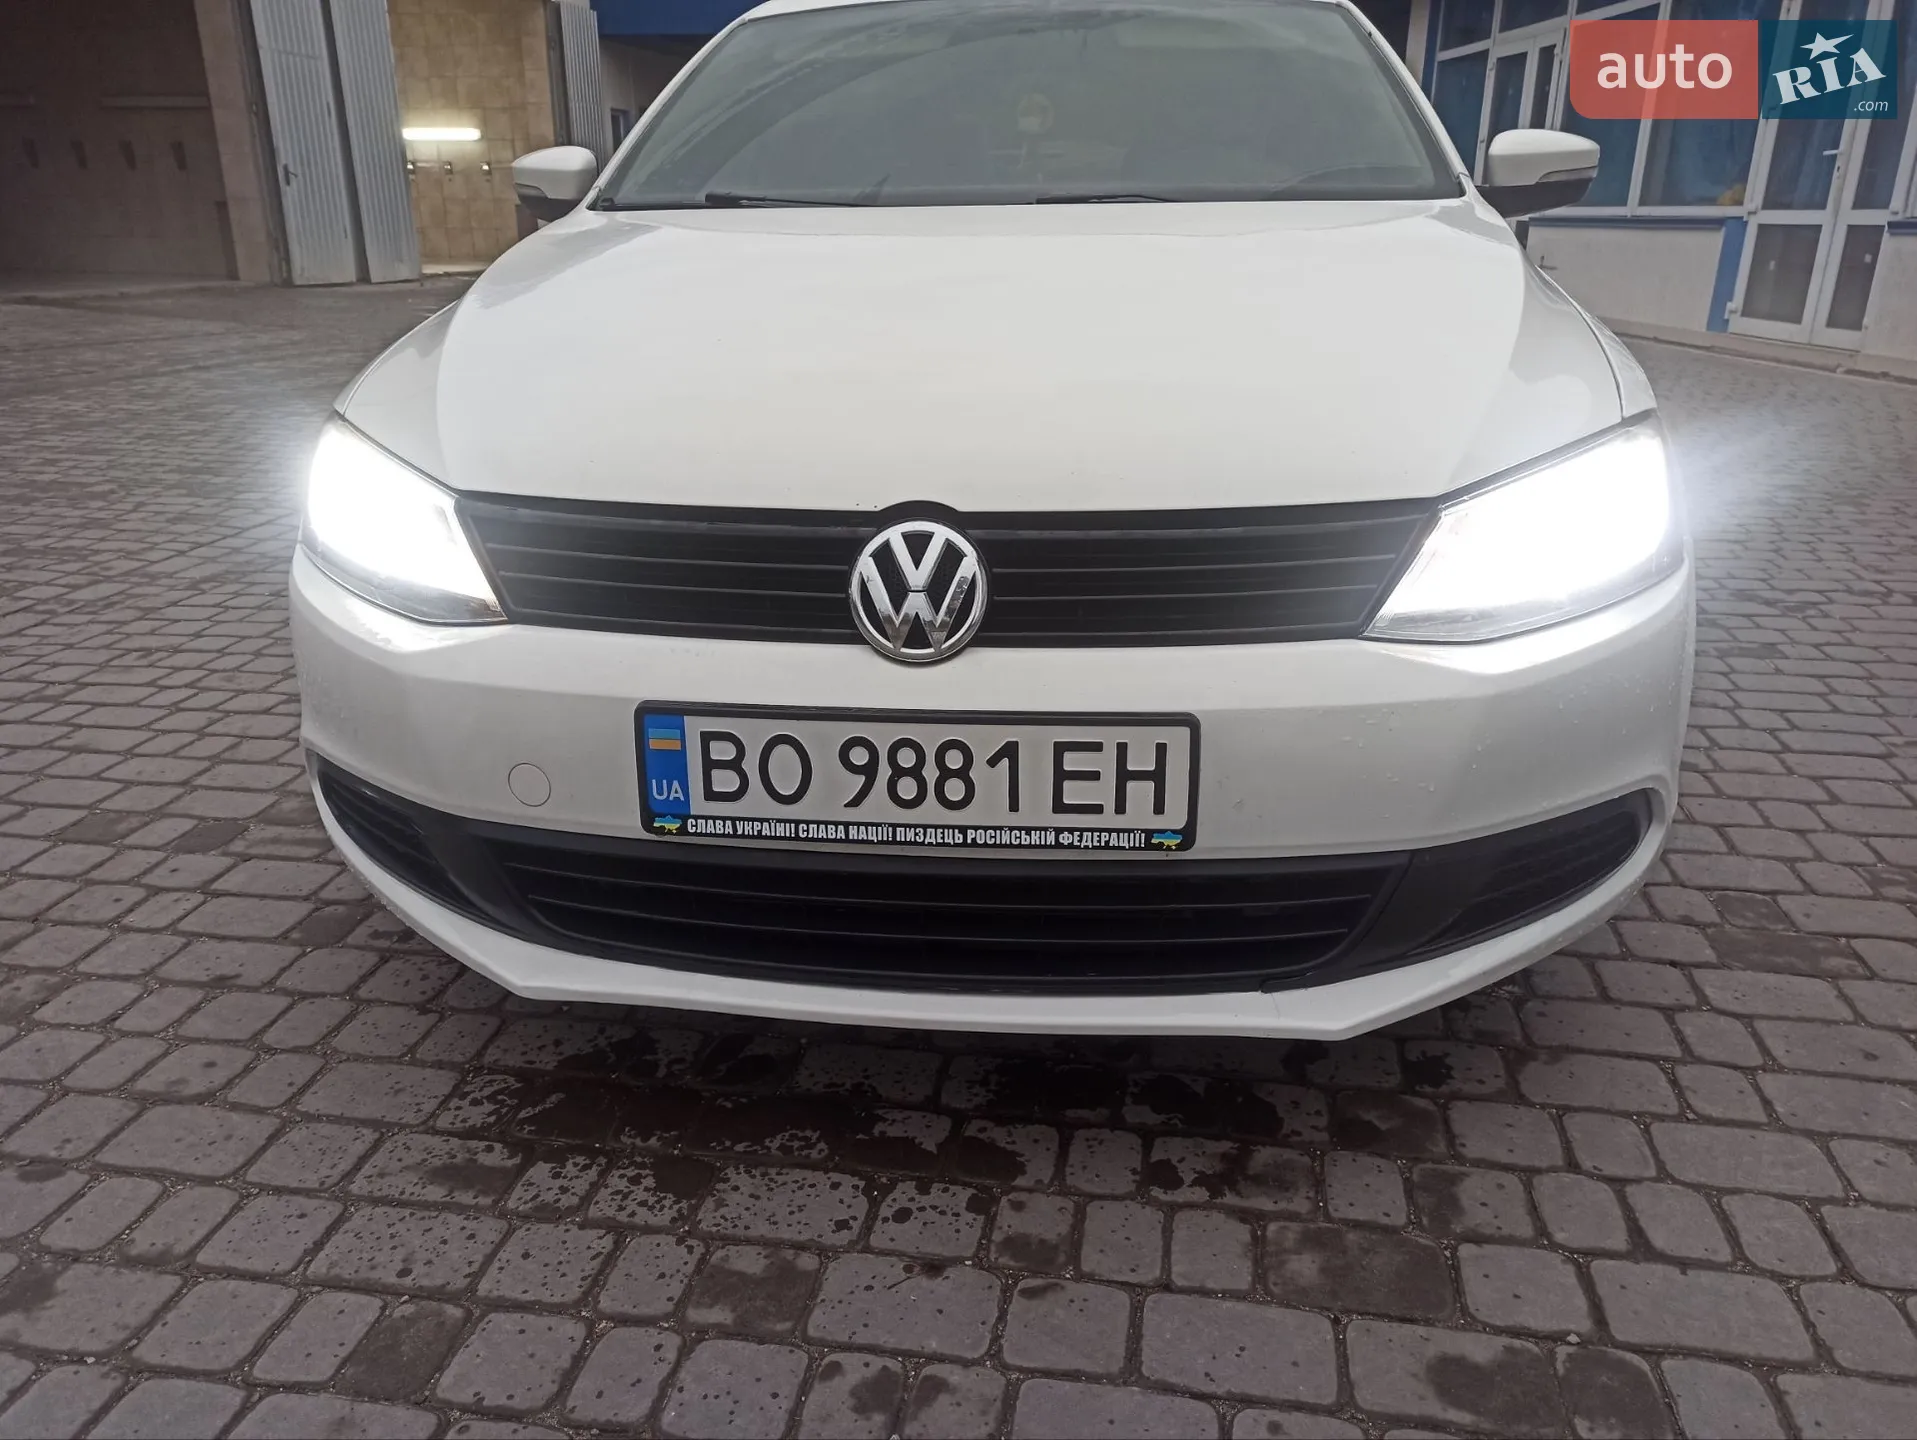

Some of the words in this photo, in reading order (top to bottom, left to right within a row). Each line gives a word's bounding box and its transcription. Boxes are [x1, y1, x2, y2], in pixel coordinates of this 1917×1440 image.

[699, 730, 813, 806] BO
[838, 735, 1020, 813] 9881
[1052, 740, 1168, 815] EH
[651, 779, 685, 801] UA
[687, 818, 733, 835] СЛАВА
[735, 819, 796, 838] УКРАЇНІ!
[798, 823, 846, 840] СЛАВА
[848, 824, 893, 843] НАЦІЇ!
[895, 827, 963, 846] ПИЗДЕЦЬ
[967, 827, 1055, 846] РОСІЙСЬКІЙ
[1058, 830, 1146, 849] ФЕДЕРАЦІЇ!
